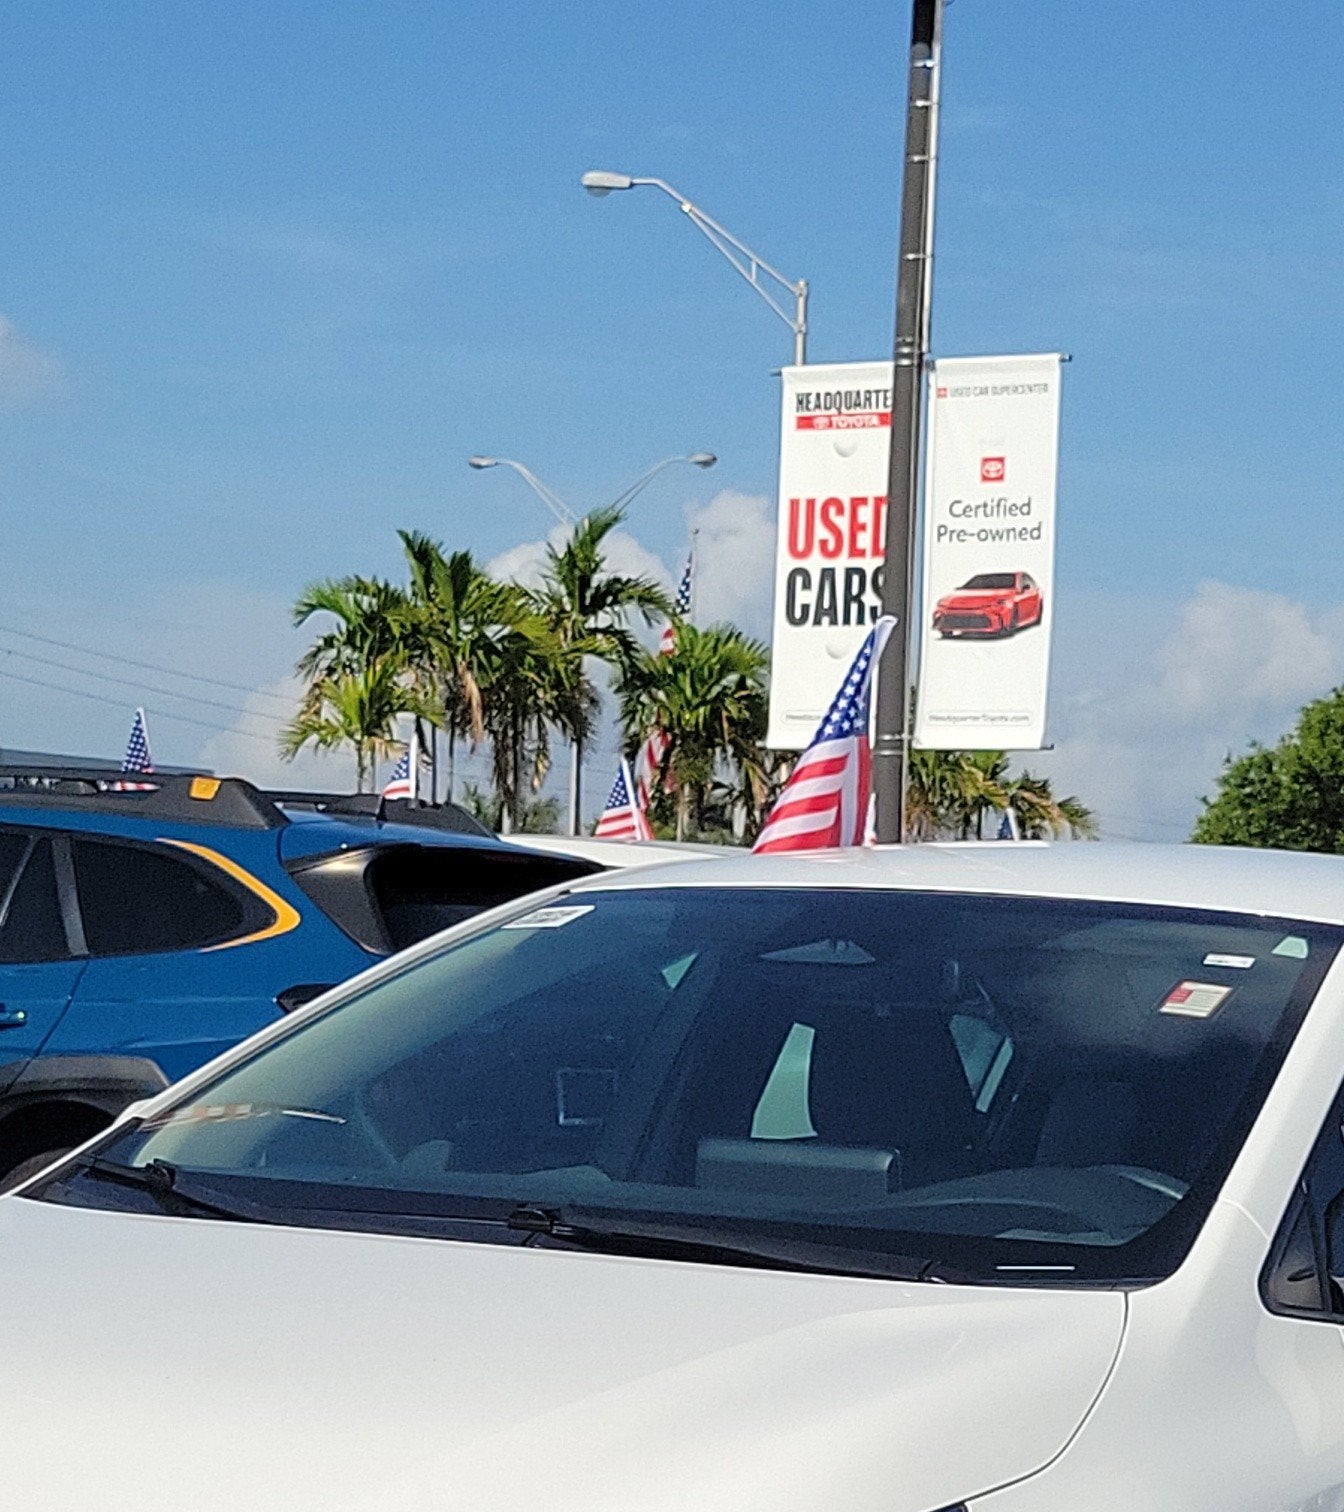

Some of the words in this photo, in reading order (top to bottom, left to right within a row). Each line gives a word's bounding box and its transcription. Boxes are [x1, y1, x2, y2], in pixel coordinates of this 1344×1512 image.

[796, 389, 892, 414] HEADQUARTE
[948, 497, 1032, 519] Certified
[936, 522, 1042, 543] Pre-owned
